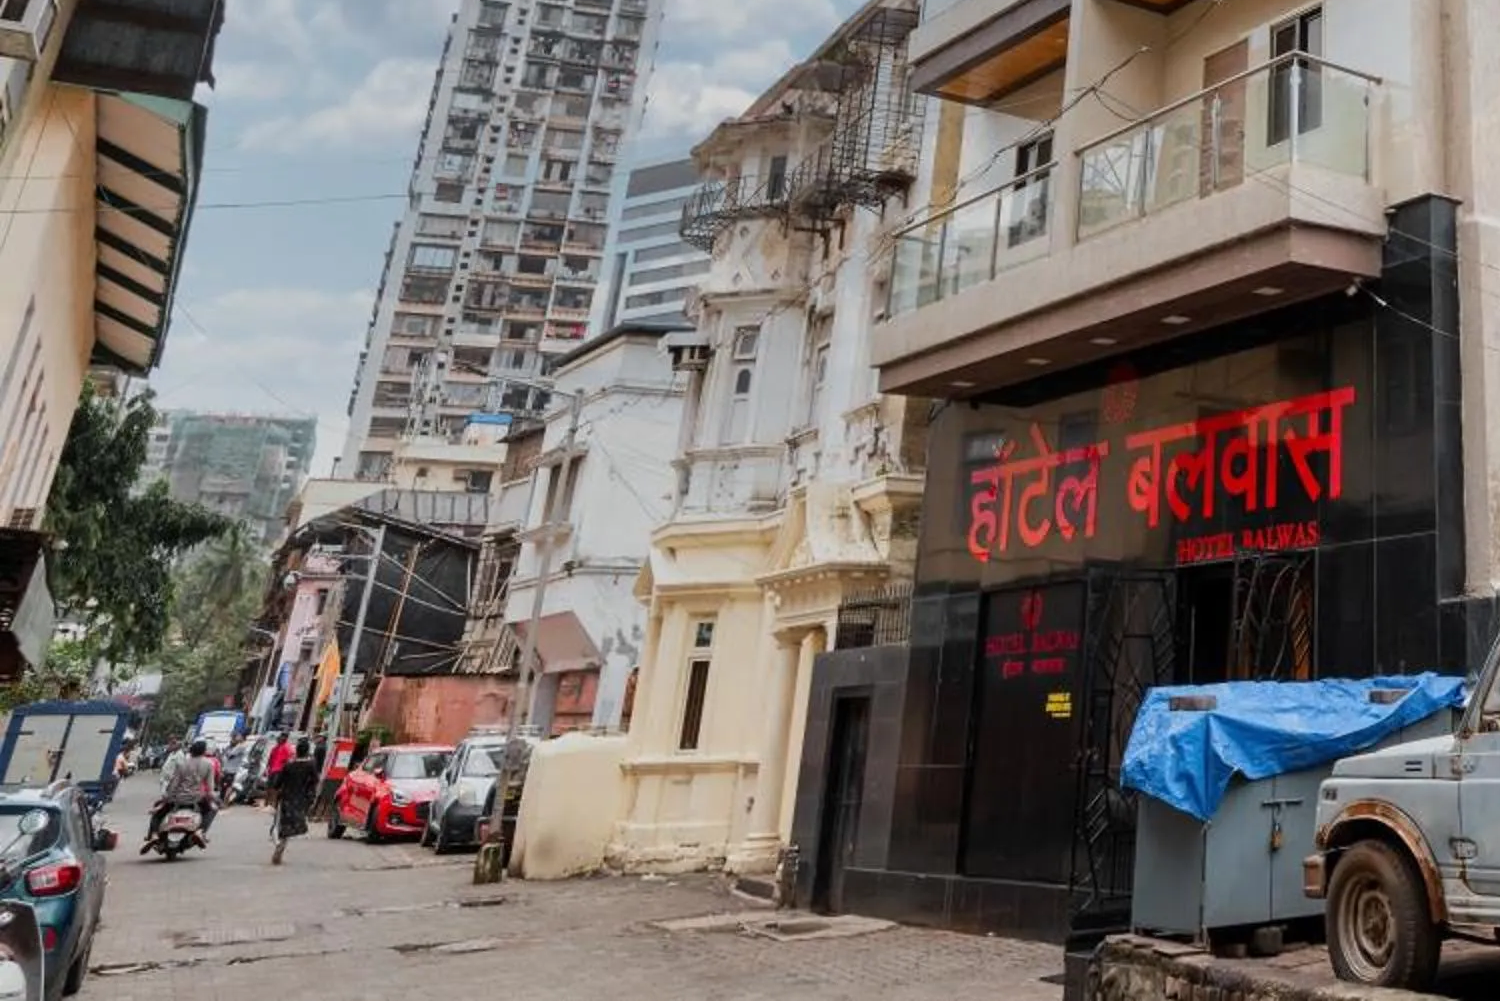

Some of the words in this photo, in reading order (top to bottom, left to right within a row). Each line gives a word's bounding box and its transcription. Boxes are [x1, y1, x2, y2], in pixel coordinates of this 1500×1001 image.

[967, 422, 1109, 563] हॉटेल
[1125, 386, 1356, 528] बलवास
[1176, 533, 1235, 565] HOTEL
[1241, 520, 1319, 550] BALWAS
